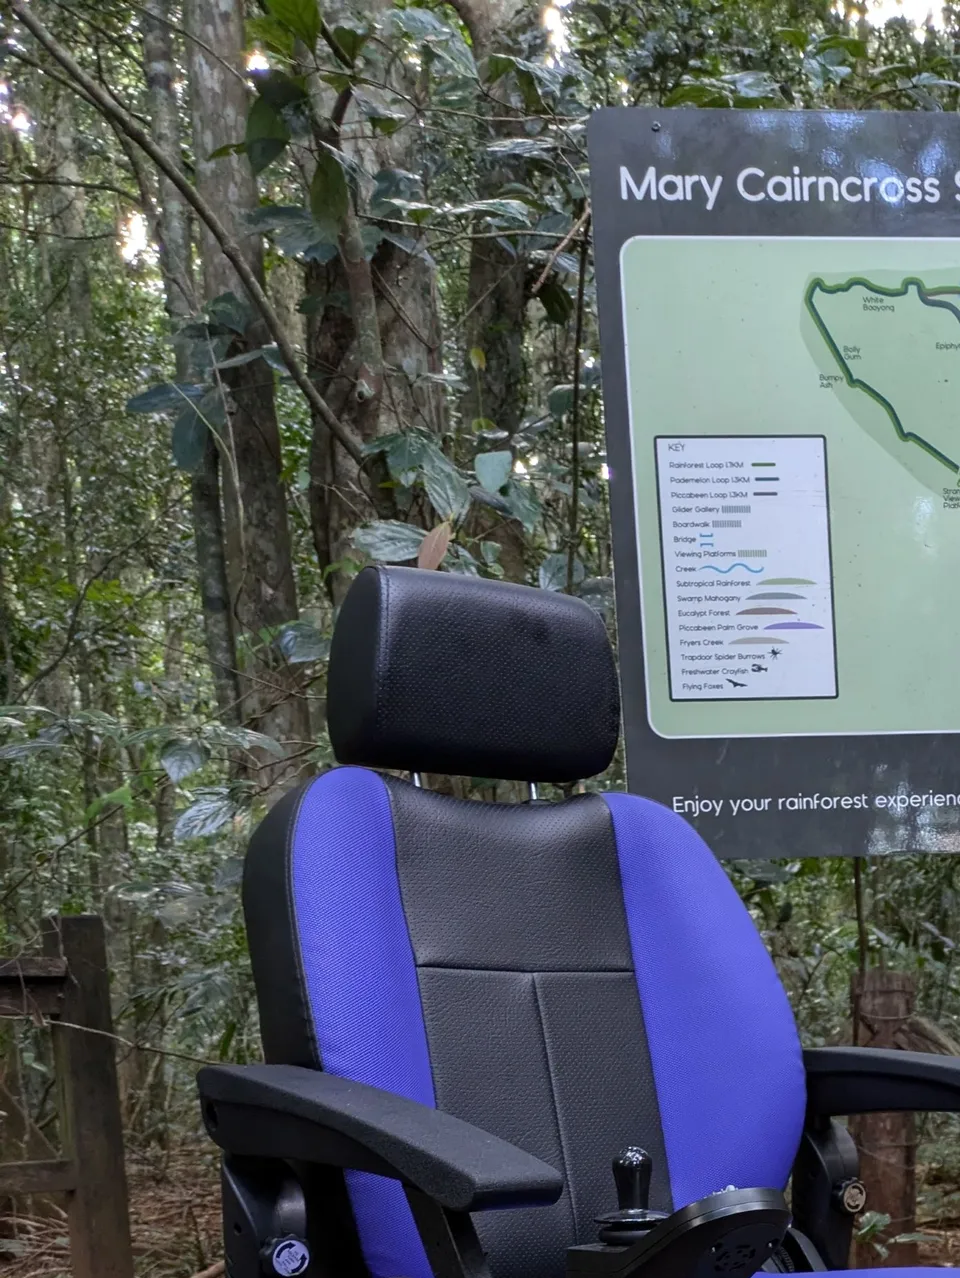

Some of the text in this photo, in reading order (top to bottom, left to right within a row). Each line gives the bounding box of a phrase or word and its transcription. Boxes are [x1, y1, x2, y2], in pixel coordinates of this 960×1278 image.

[619, 165, 723, 211] Mary
[736, 166, 941, 203] Cairncross
[862, 296, 884, 304] White
[863, 304, 895, 312] Booyong
[819, 374, 844, 382] Bumpy
[819, 381, 833, 389] Ash
[667, 443, 686, 452] KEY
[669, 461, 725, 471] Rainforest Loop
[711, 476, 730, 485] Loop
[670, 491, 728, 500] Piccabeen Loop
[671, 505, 720, 514] Glider Gallery
[672, 520, 711, 528] Boardwalk
[673, 535, 697, 544] Bridge
[674, 550, 737, 559] Viewing Platforms
[675, 565, 697, 573] Creek
[676, 579, 752, 588] Subtropical Rainforest
[677, 594, 741, 603] Swamp Mahogany
[677, 609, 731, 618] Eucalypt Forest
[678, 623, 759, 632] Piccabeen Palm Grove
[679, 638, 724, 647] Fryers Creek
[680, 652, 766, 662] Trapdoor Spider Burrows
[681, 667, 749, 676] Freshwater Crayfish
[682, 682, 724, 691] Flying Foxes
[672, 795, 723, 817] Enjoy
[729, 797, 772, 816] your
[778, 793, 869, 811] rainforest
